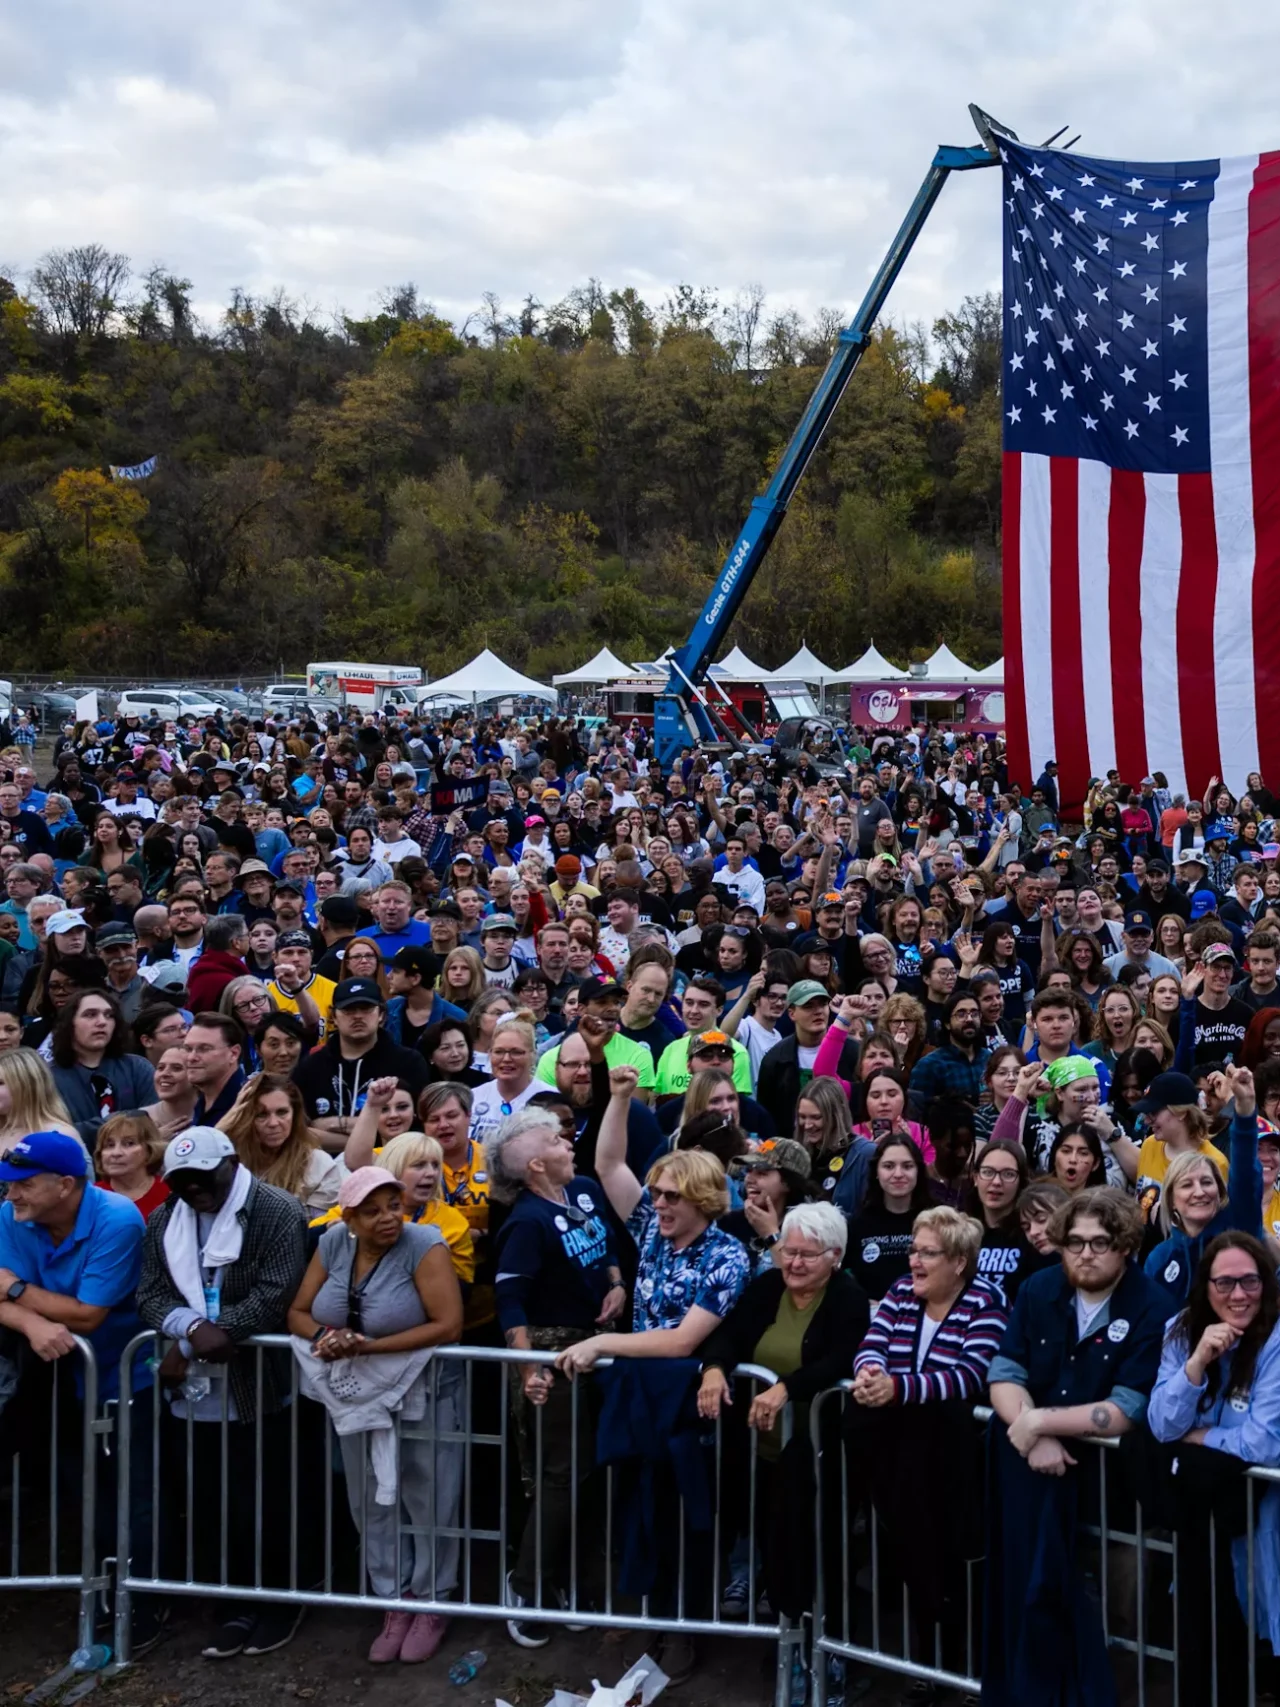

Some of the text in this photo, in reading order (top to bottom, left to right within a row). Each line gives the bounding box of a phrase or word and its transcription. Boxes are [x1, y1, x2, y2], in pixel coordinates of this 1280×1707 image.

[705, 539, 751, 625] Genie GTH-844
[861, 1235, 890, 1247] STRONG
